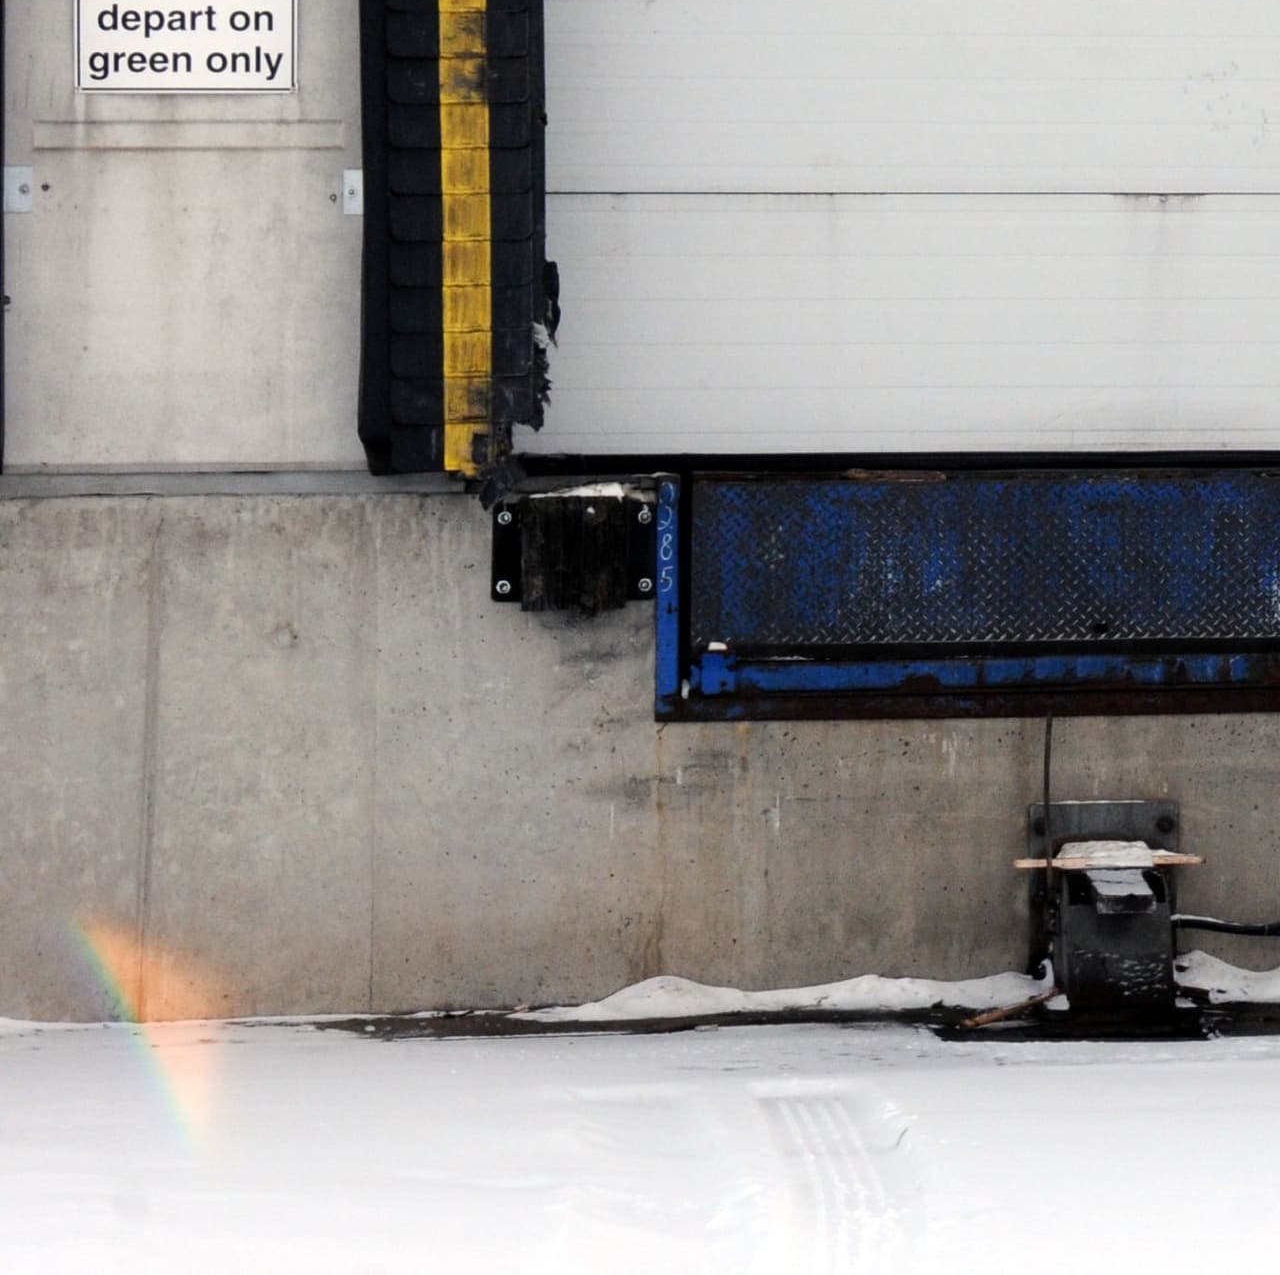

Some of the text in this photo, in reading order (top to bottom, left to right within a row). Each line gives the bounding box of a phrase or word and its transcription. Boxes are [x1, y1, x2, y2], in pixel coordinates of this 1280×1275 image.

[97, 3, 274, 39] depart on
[88, 45, 283, 81] green only
